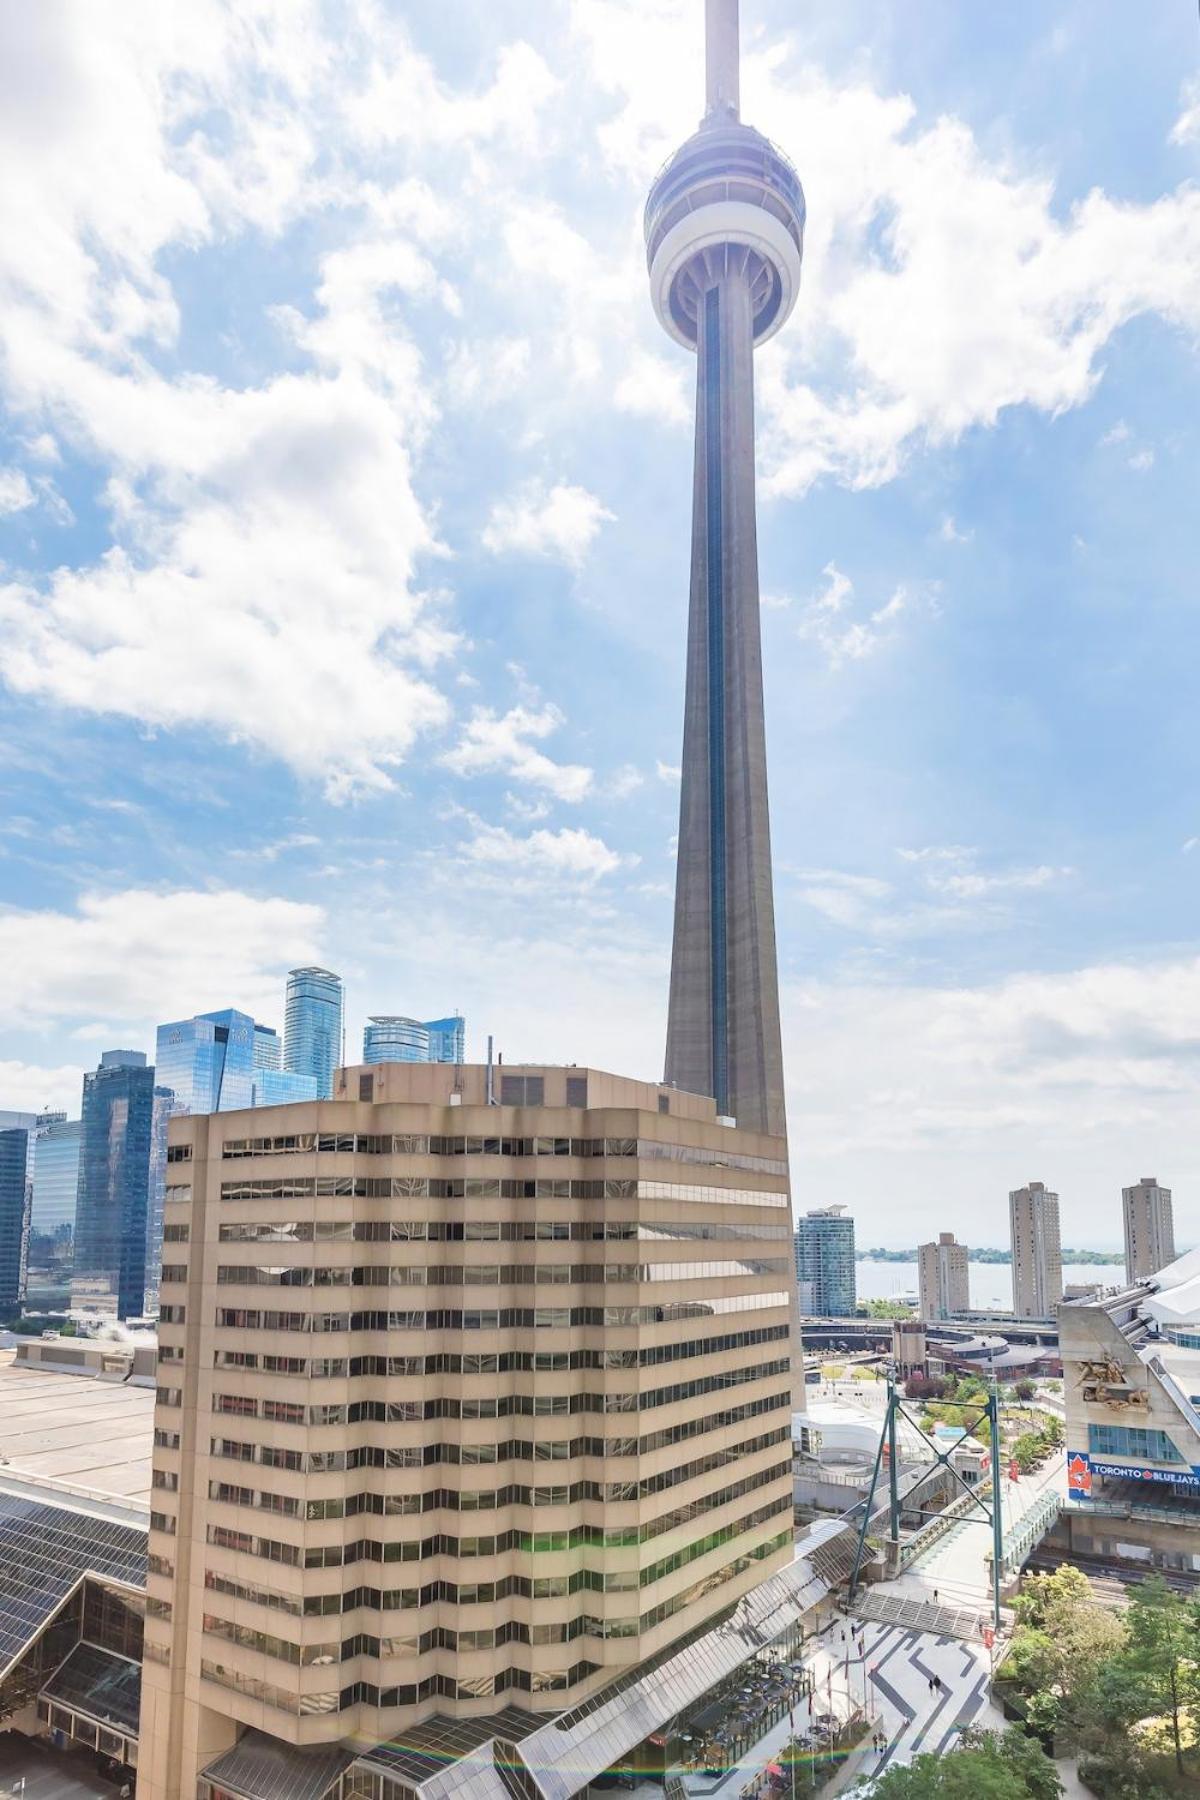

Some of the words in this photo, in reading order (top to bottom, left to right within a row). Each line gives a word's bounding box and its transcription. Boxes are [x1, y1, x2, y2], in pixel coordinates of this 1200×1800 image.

[1094, 1465, 1142, 1478] TORONTO
[1153, 1471, 1175, 1482] BLUE
[1176, 1474, 1200, 1485] JAYS
